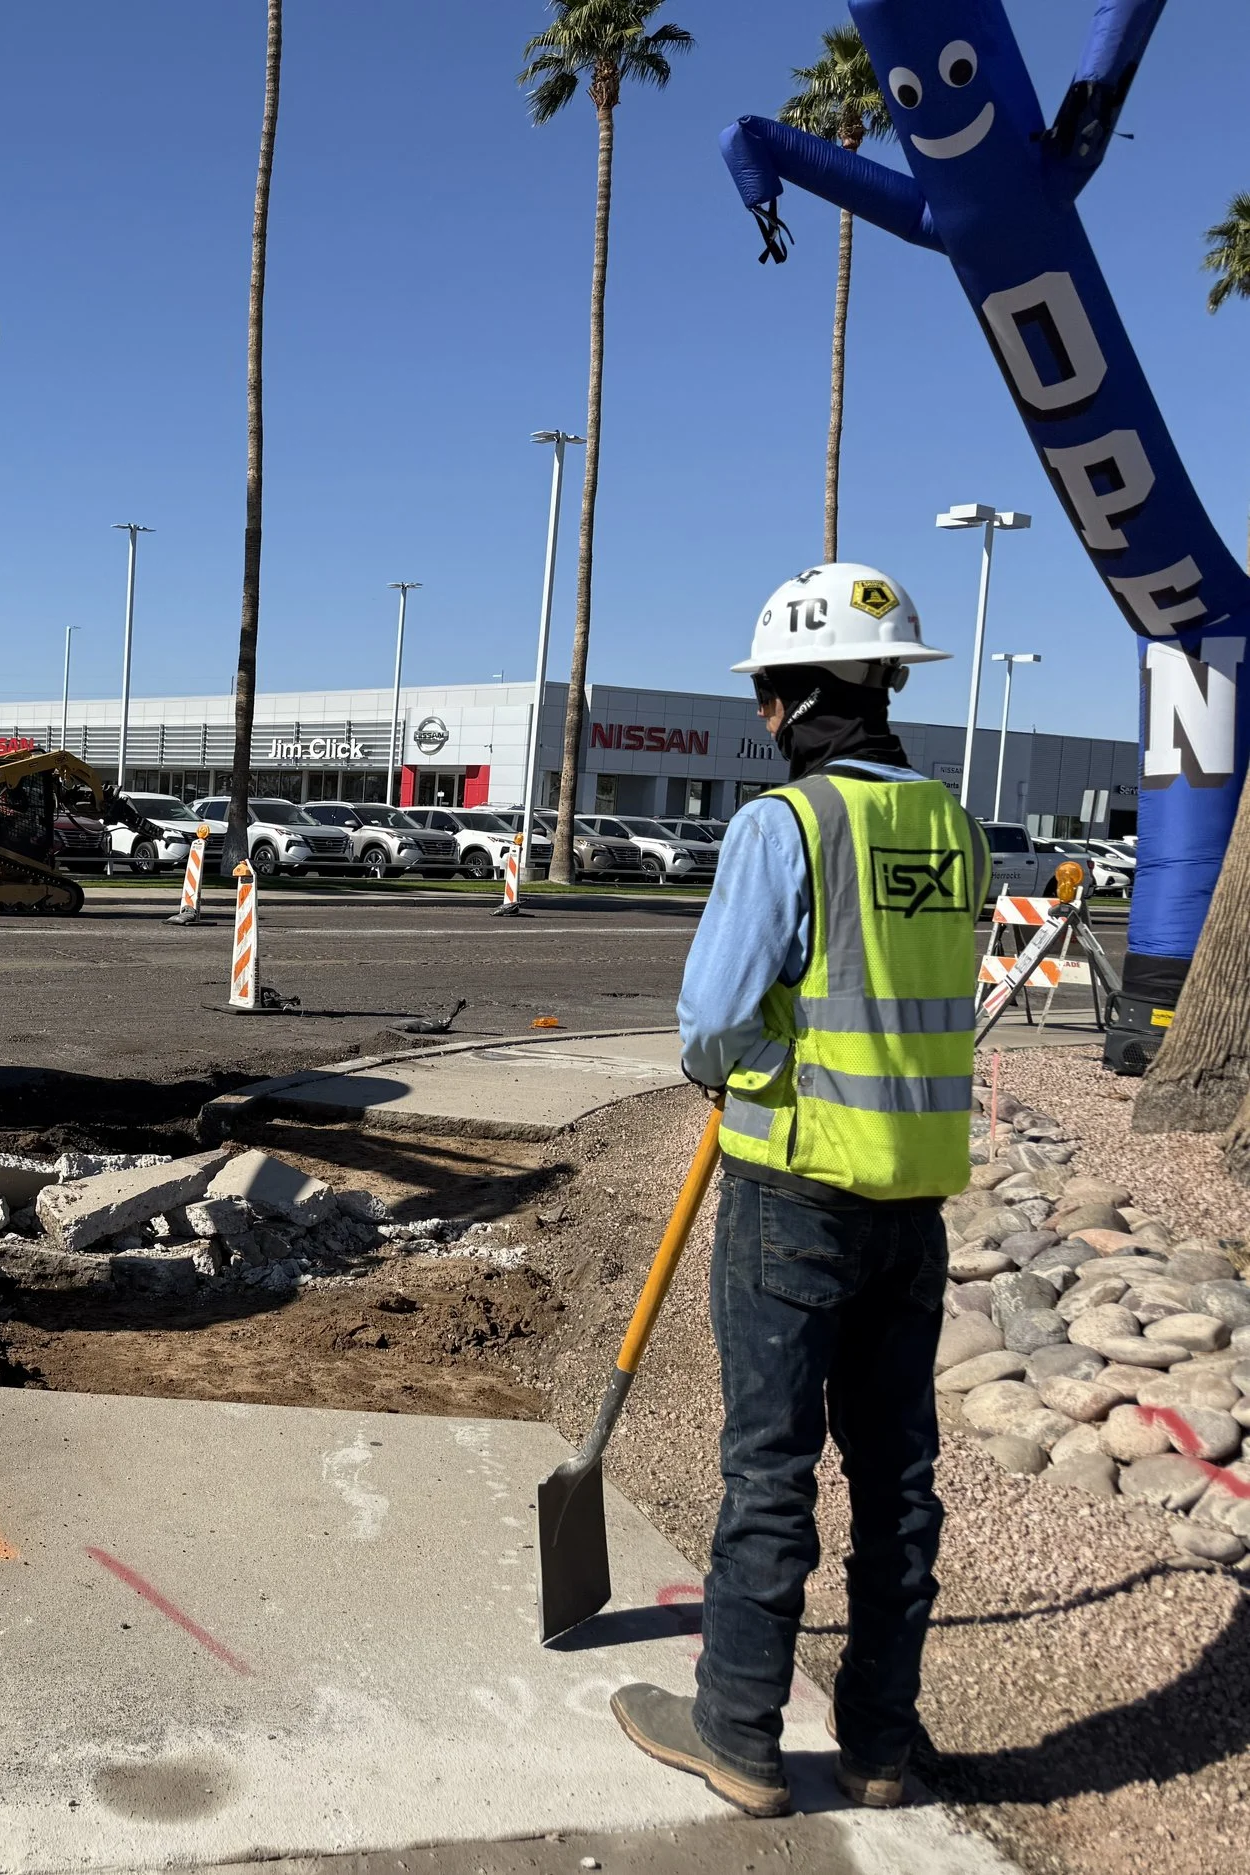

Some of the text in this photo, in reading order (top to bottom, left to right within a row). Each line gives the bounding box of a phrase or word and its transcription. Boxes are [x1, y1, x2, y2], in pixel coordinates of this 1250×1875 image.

[982, 271, 1247, 786] OPEN
[268, 738, 365, 760] Jim Click
[590, 722, 710, 755] NISSAN
[737, 737, 775, 761] Jim
[1117, 784, 1139, 796] Serv
